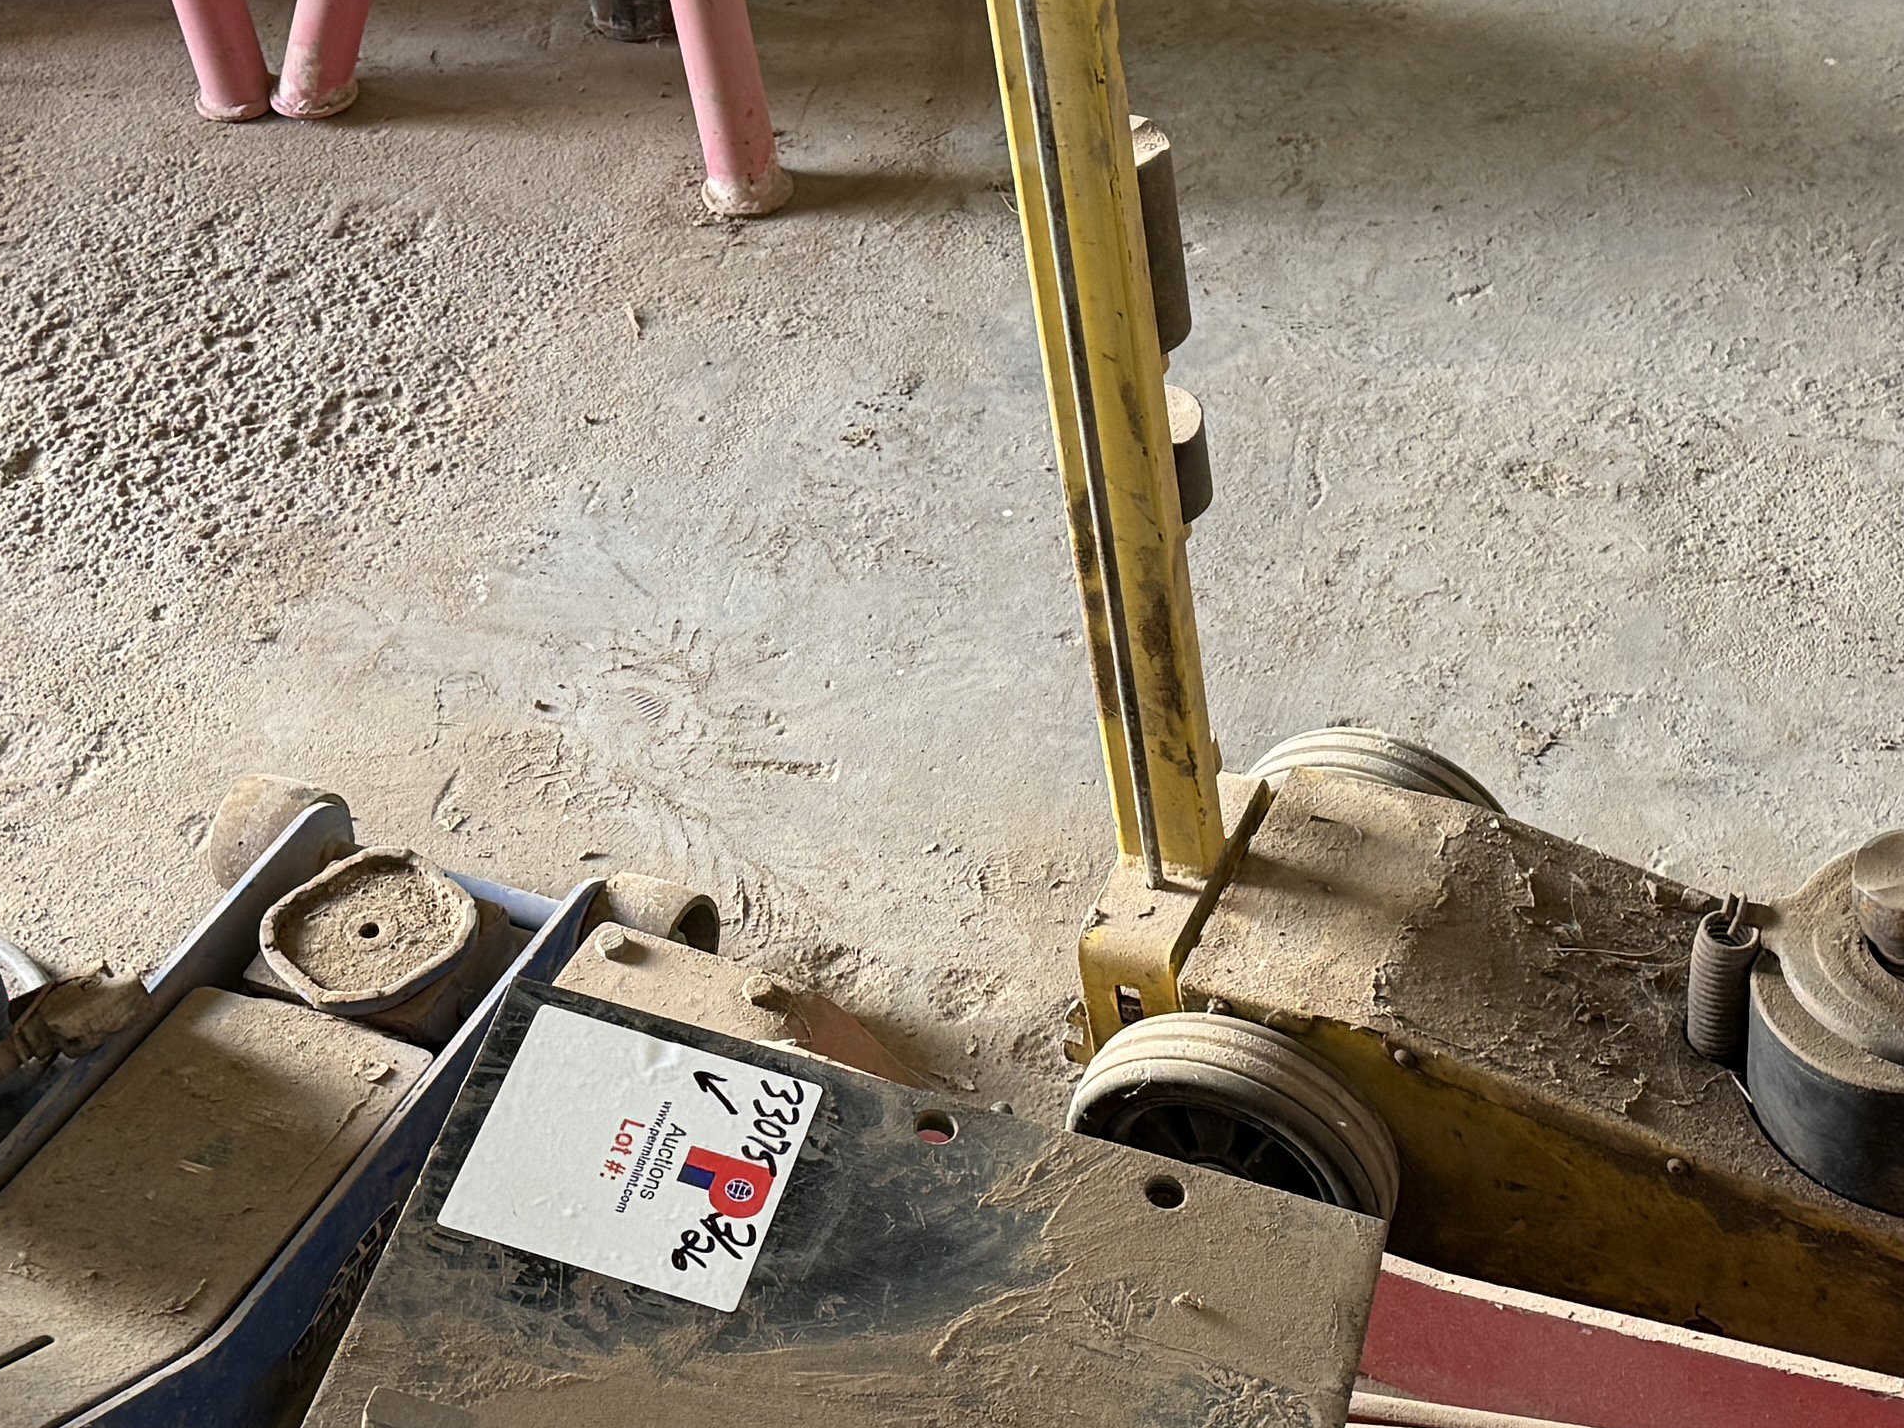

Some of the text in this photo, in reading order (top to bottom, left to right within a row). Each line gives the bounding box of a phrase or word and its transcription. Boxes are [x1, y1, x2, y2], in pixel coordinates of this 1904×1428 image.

[599, 1118, 645, 1180] Lot #:
[614, 1100, 673, 1214] www.permianint.com
[639, 1123, 687, 1201] Auctions
[741, 1079, 805, 1178] 33075
